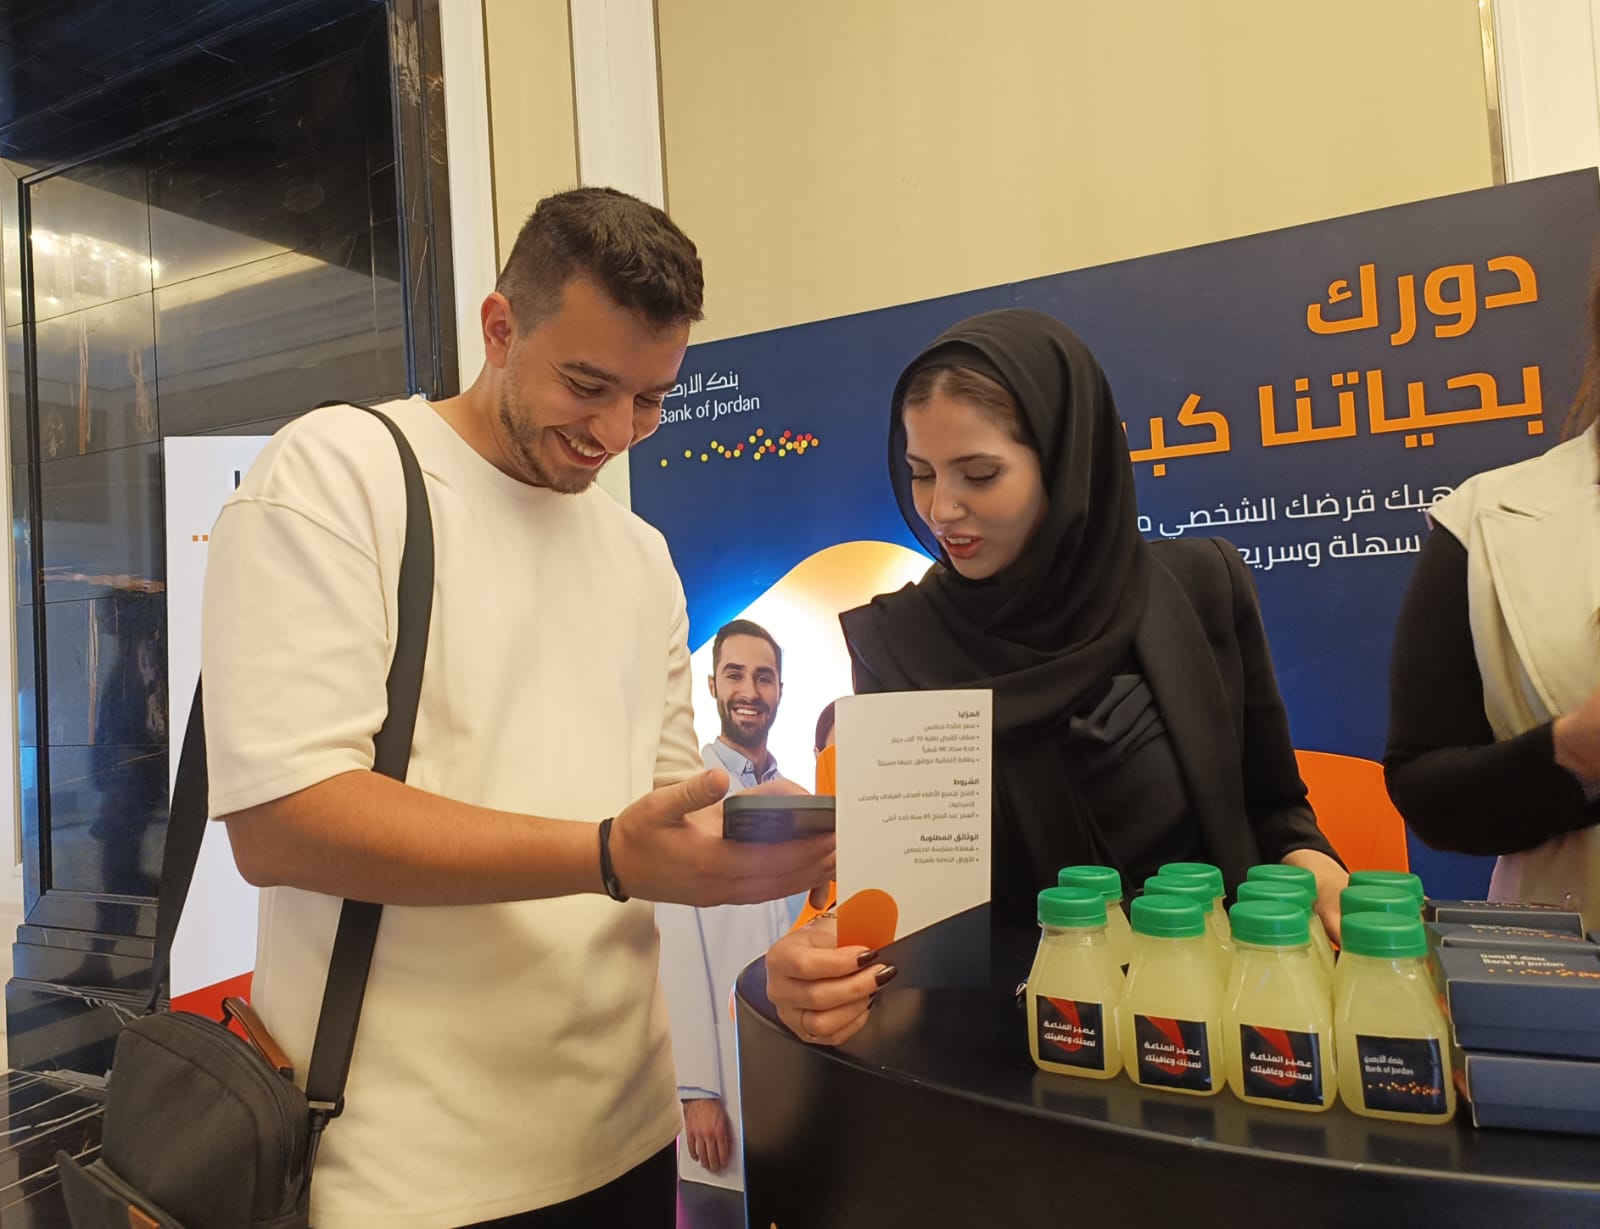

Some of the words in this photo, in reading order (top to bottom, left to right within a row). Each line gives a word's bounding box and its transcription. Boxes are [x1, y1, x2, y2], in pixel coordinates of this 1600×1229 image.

[1306, 255, 1538, 346] دورك
[666, 372, 702, 398] الارد
[706, 371, 739, 391] بنك
[659, 403, 693, 425] Bank
[696, 400, 710, 418] of
[712, 395, 760, 421] Jordan
[1258, 365, 1544, 448] بحياتنا
[1122, 393, 1231, 477] كب
[1285, 489, 1375, 522] قرضك
[1160, 497, 1276, 539] الشخصي
[1328, 533, 1421, 558] سهلة
[1237, 541, 1321, 570] وسريع
[958, 710, 980, 720] المزايا
[953, 776, 979, 787] الشروط
[919, 833, 953, 843] المطلوبة
[953, 832, 979, 843] الوثائق
[1043, 1020, 1072, 1034] المناعة
[1073, 1024, 1096, 1036] عصير
[1044, 1032, 1072, 1045] وعافيتك
[1072, 1036, 1096, 1048] لصحتك
[1144, 1041, 1175, 1053] المناعة
[1176, 1045, 1201, 1057] عصير
[1145, 1053, 1176, 1067] وعافيتك
[1176, 1057, 1202, 1069] لصحتك
[1250, 1052, 1283, 1064] المناعة
[1284, 1056, 1313, 1069] عصير
[1250, 1064, 1284, 1079] وعافيتك
[1285, 1069, 1313, 1081] لصحتك
